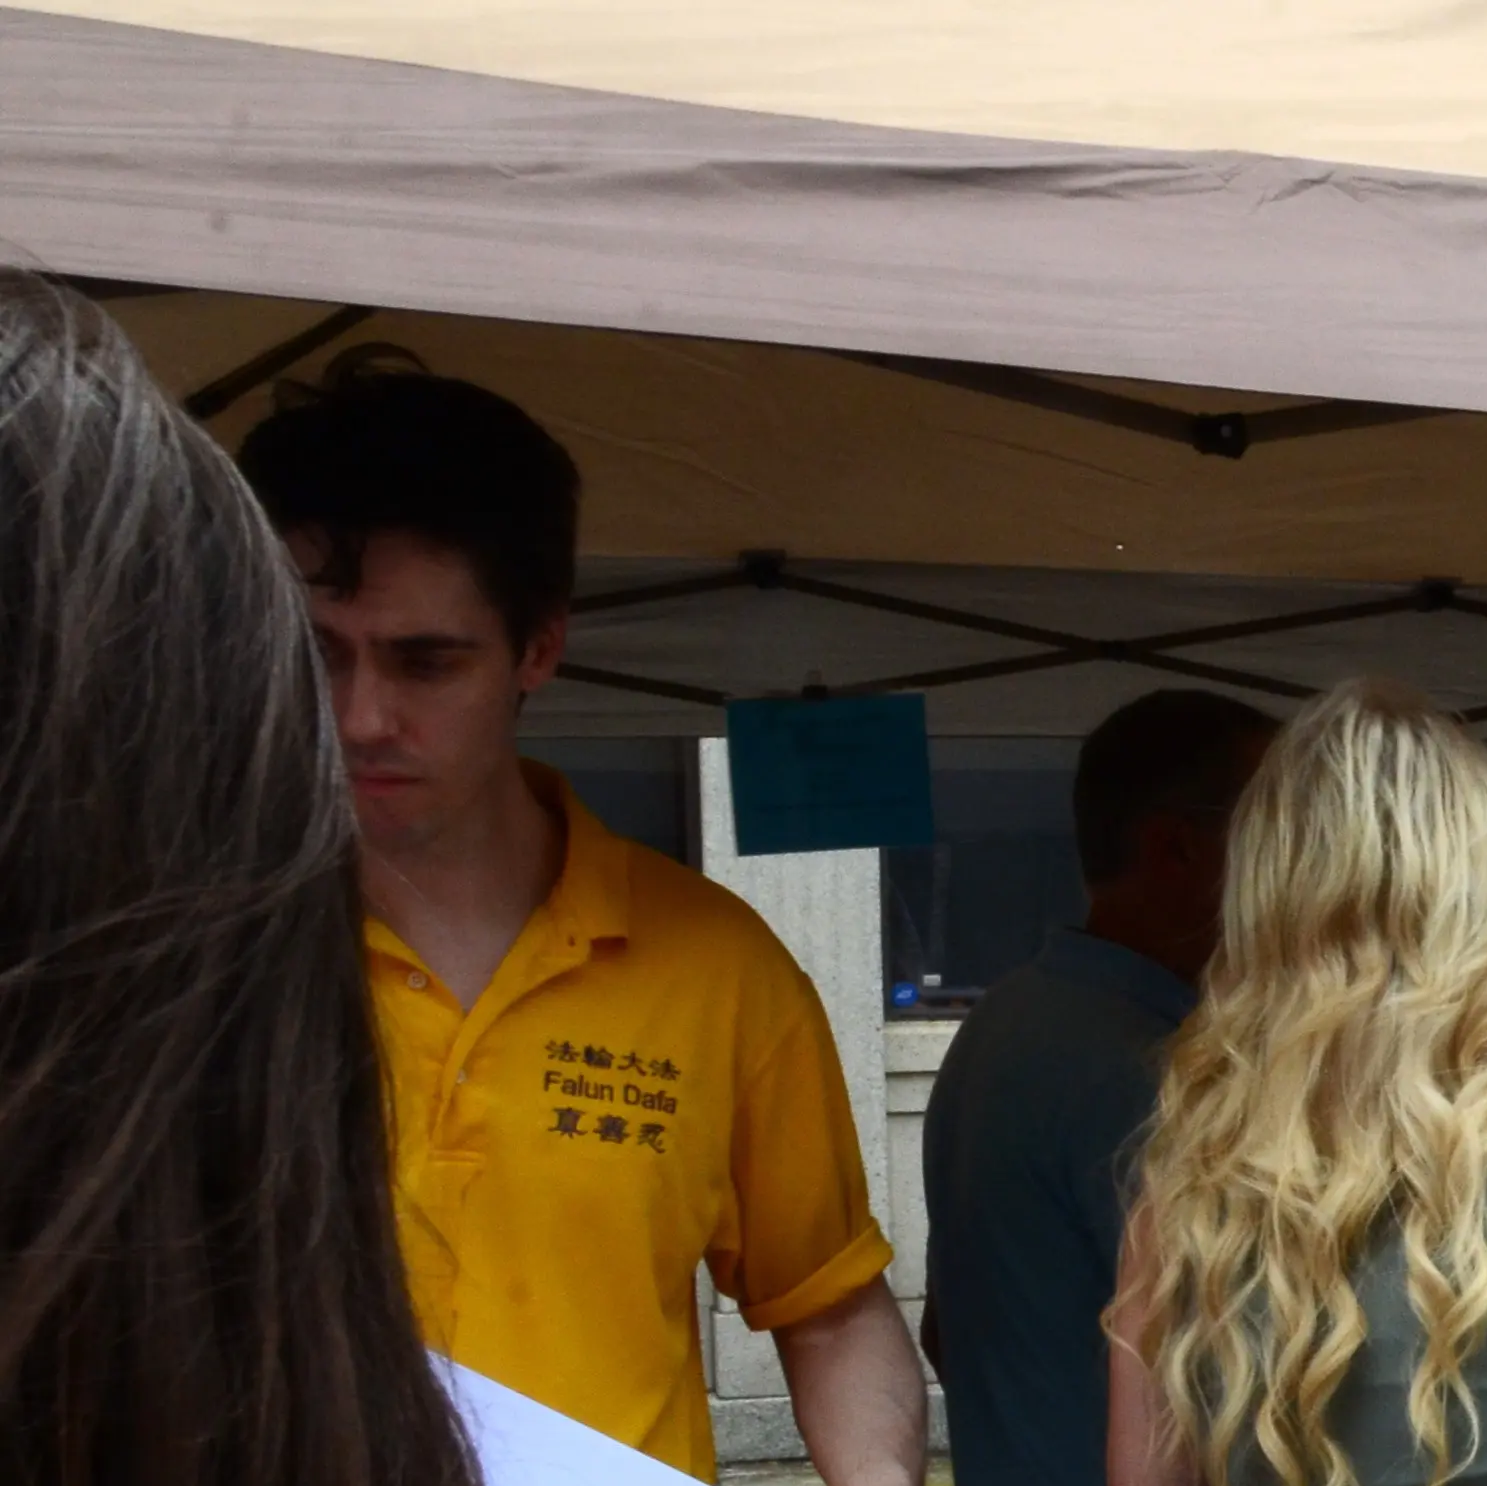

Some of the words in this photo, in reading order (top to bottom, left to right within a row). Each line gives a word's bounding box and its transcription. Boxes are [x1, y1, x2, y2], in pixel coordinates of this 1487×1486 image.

[544, 1040, 682, 1081] 法輪大法
[544, 1070, 614, 1104] Falun
[623, 1082, 678, 1115] Dafa
